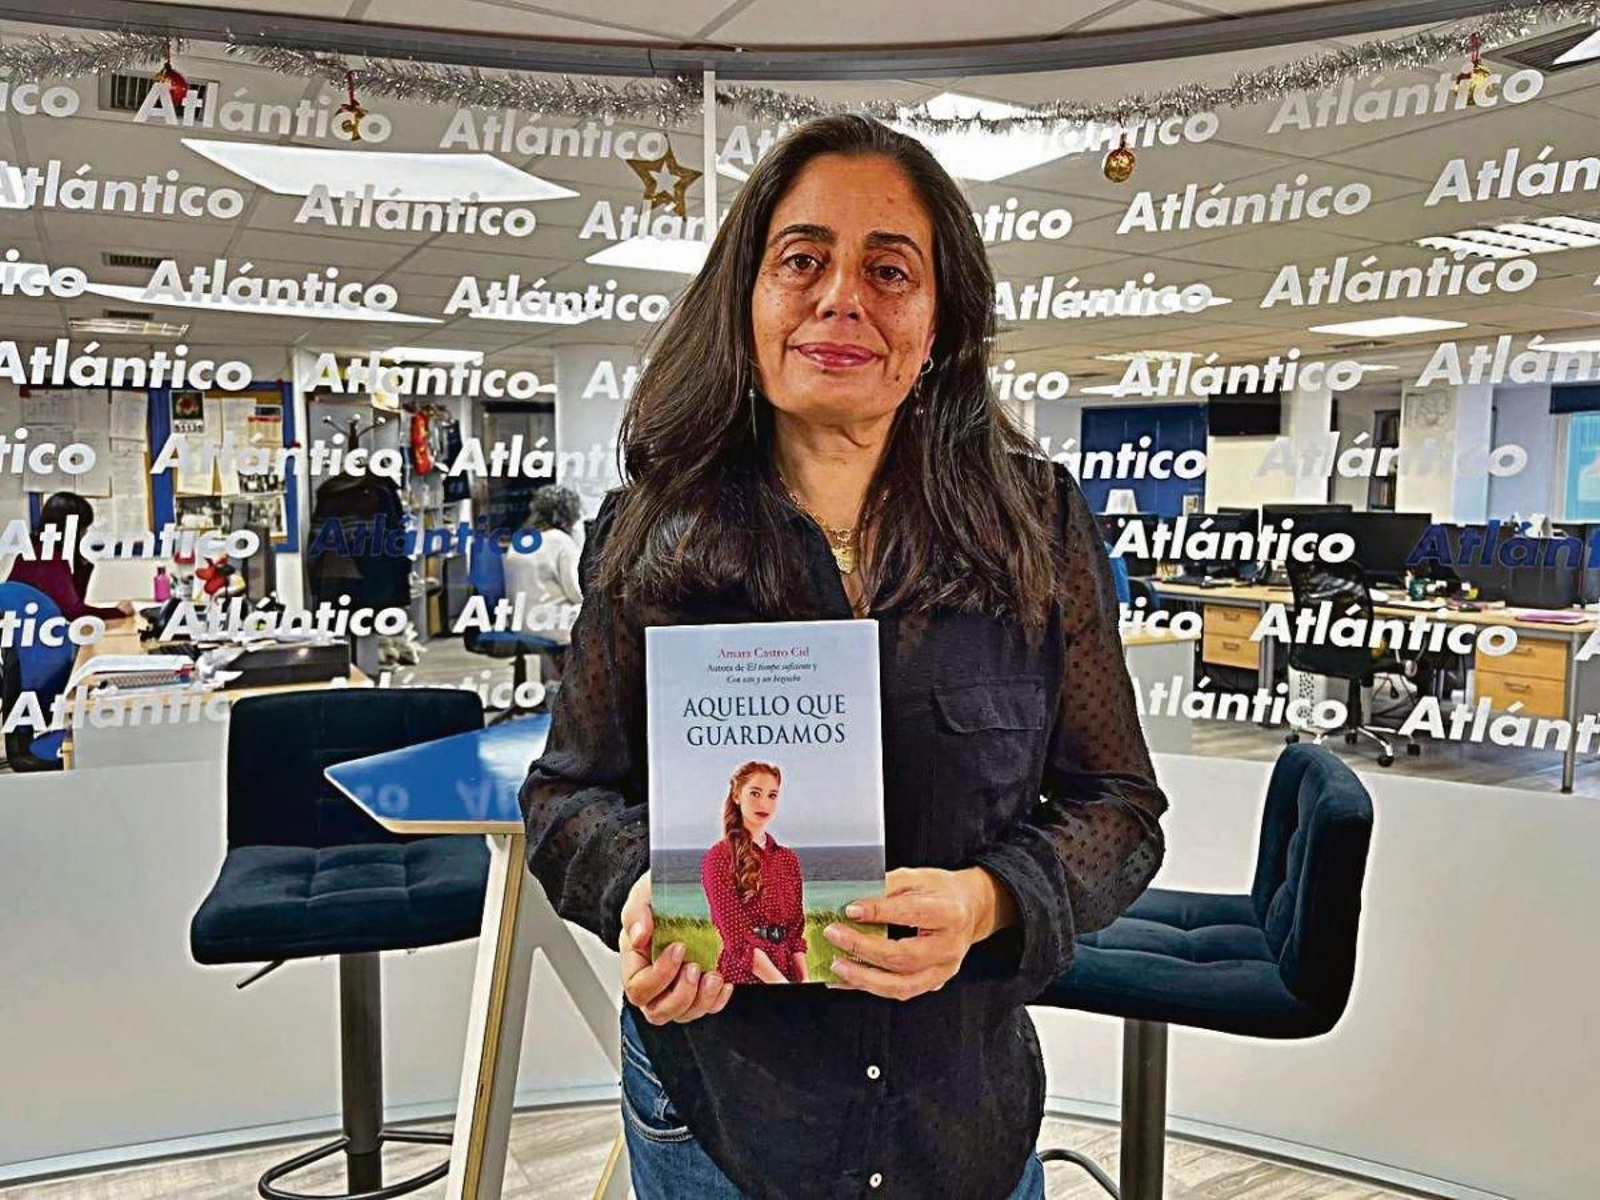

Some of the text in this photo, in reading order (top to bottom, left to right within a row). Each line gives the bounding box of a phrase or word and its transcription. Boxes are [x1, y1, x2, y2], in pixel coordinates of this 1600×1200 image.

[133, 81, 392, 143] Atlántico
[1267, 66, 1544, 134] Atlántico
[440, 108, 669, 161] Atlántico
[294, 184, 536, 237] Atlántico
[579, 199, 728, 242] Atlán
[1116, 173, 1372, 235] Atlántico
[143, 258, 398, 312] Atlántico
[443, 274, 670, 323] Atlántico
[994, 272, 1214, 321] Atlántico
[1260, 249, 1538, 308] Atlántico
[1112, 348, 1364, 398] Atlántico
[150, 431, 403, 477] Atlántico
[1257, 432, 1528, 477] Atlántico
[309, 512, 543, 557] Atlántico
[1110, 517, 1355, 565] Atlántico
[160, 594, 408, 642] Atlántico
[1250, 600, 1518, 657] Atlántico
[707, 664, 733, 673] Autora
[735, 663, 745, 672] de
[718, 646, 810, 658] Amara Castro Cid
[683, 693, 846, 721] AQUELLO QUE
[686, 722, 846, 746] GUARDAMOS
